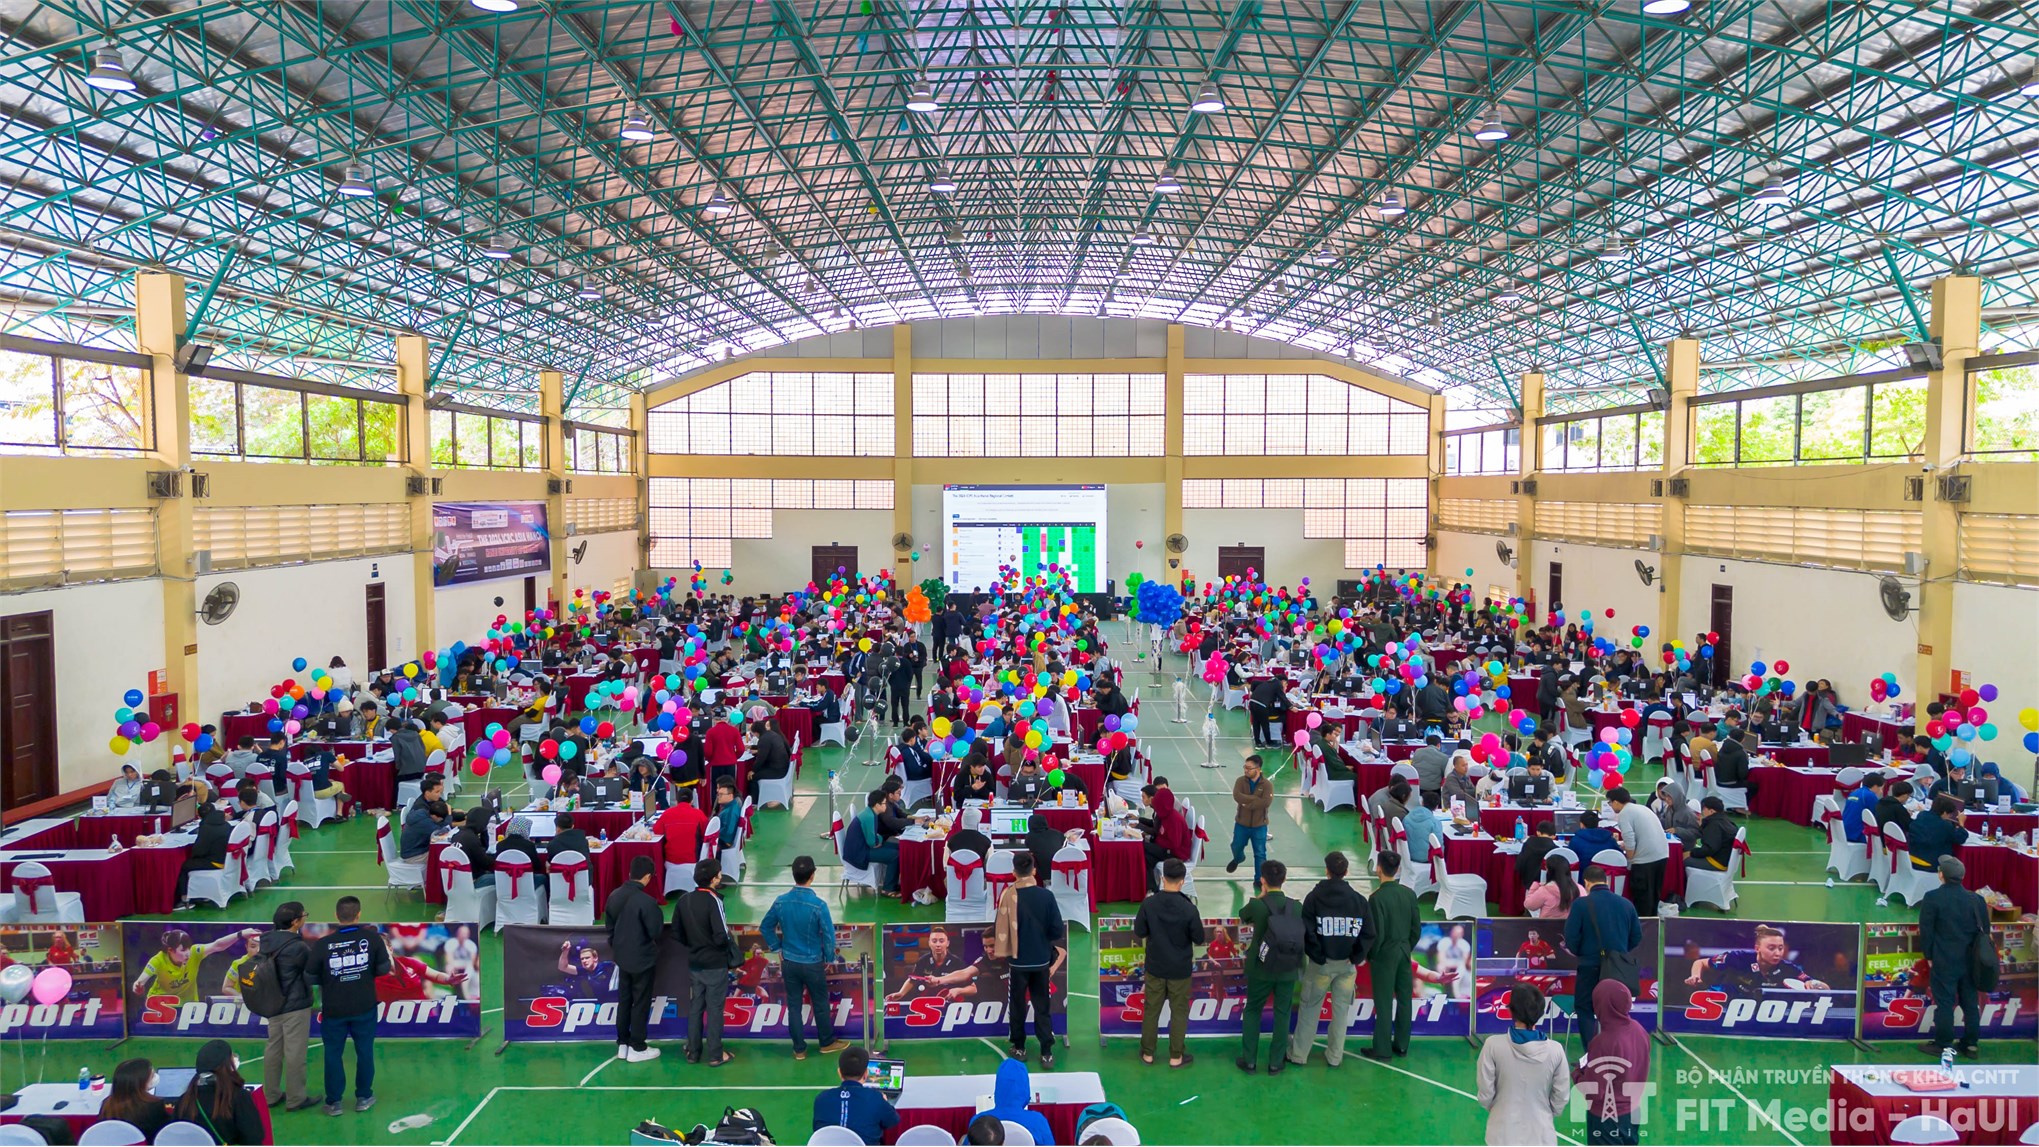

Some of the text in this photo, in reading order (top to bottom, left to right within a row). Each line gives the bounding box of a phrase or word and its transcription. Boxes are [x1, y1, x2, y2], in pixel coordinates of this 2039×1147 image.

[1316, 916, 1363, 938] CODES
[1103, 954, 1126, 963] FEEL
[1868, 960, 1891, 969] FEEL
[0, 998, 103, 1034] port
[142, 995, 269, 1030] Spor
[526, 996, 669, 1033] Spot
[723, 997, 854, 1033] Spot
[1684, 990, 1833, 1028] Sport
